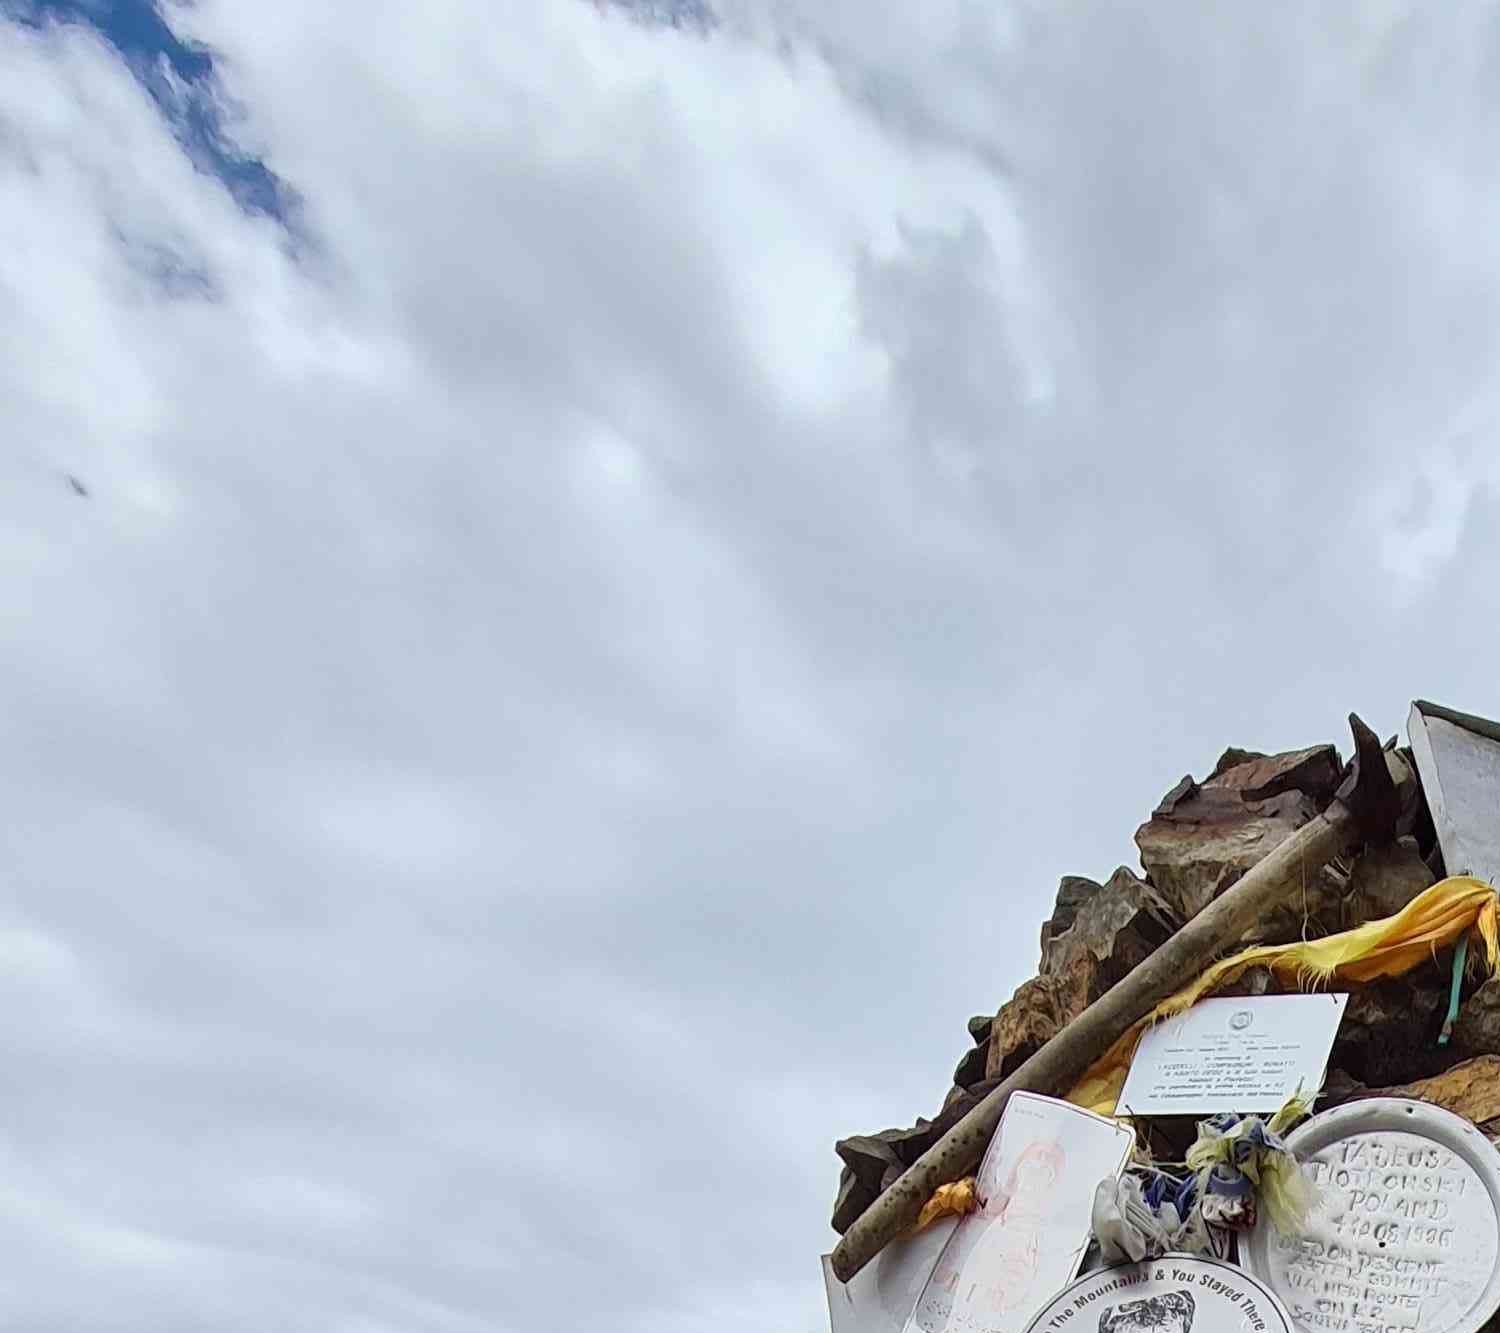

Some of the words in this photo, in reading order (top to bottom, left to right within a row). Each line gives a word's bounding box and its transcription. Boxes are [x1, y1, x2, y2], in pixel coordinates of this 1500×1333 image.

[1050, 1307, 1074, 1328] The
[1074, 1272, 1150, 1310] Mountains
[1154, 1269, 1165, 1280] &
[1172, 1268, 1196, 1283] You
[1199, 1274, 1241, 1302] Stayed
[1240, 1298, 1266, 1332] There
